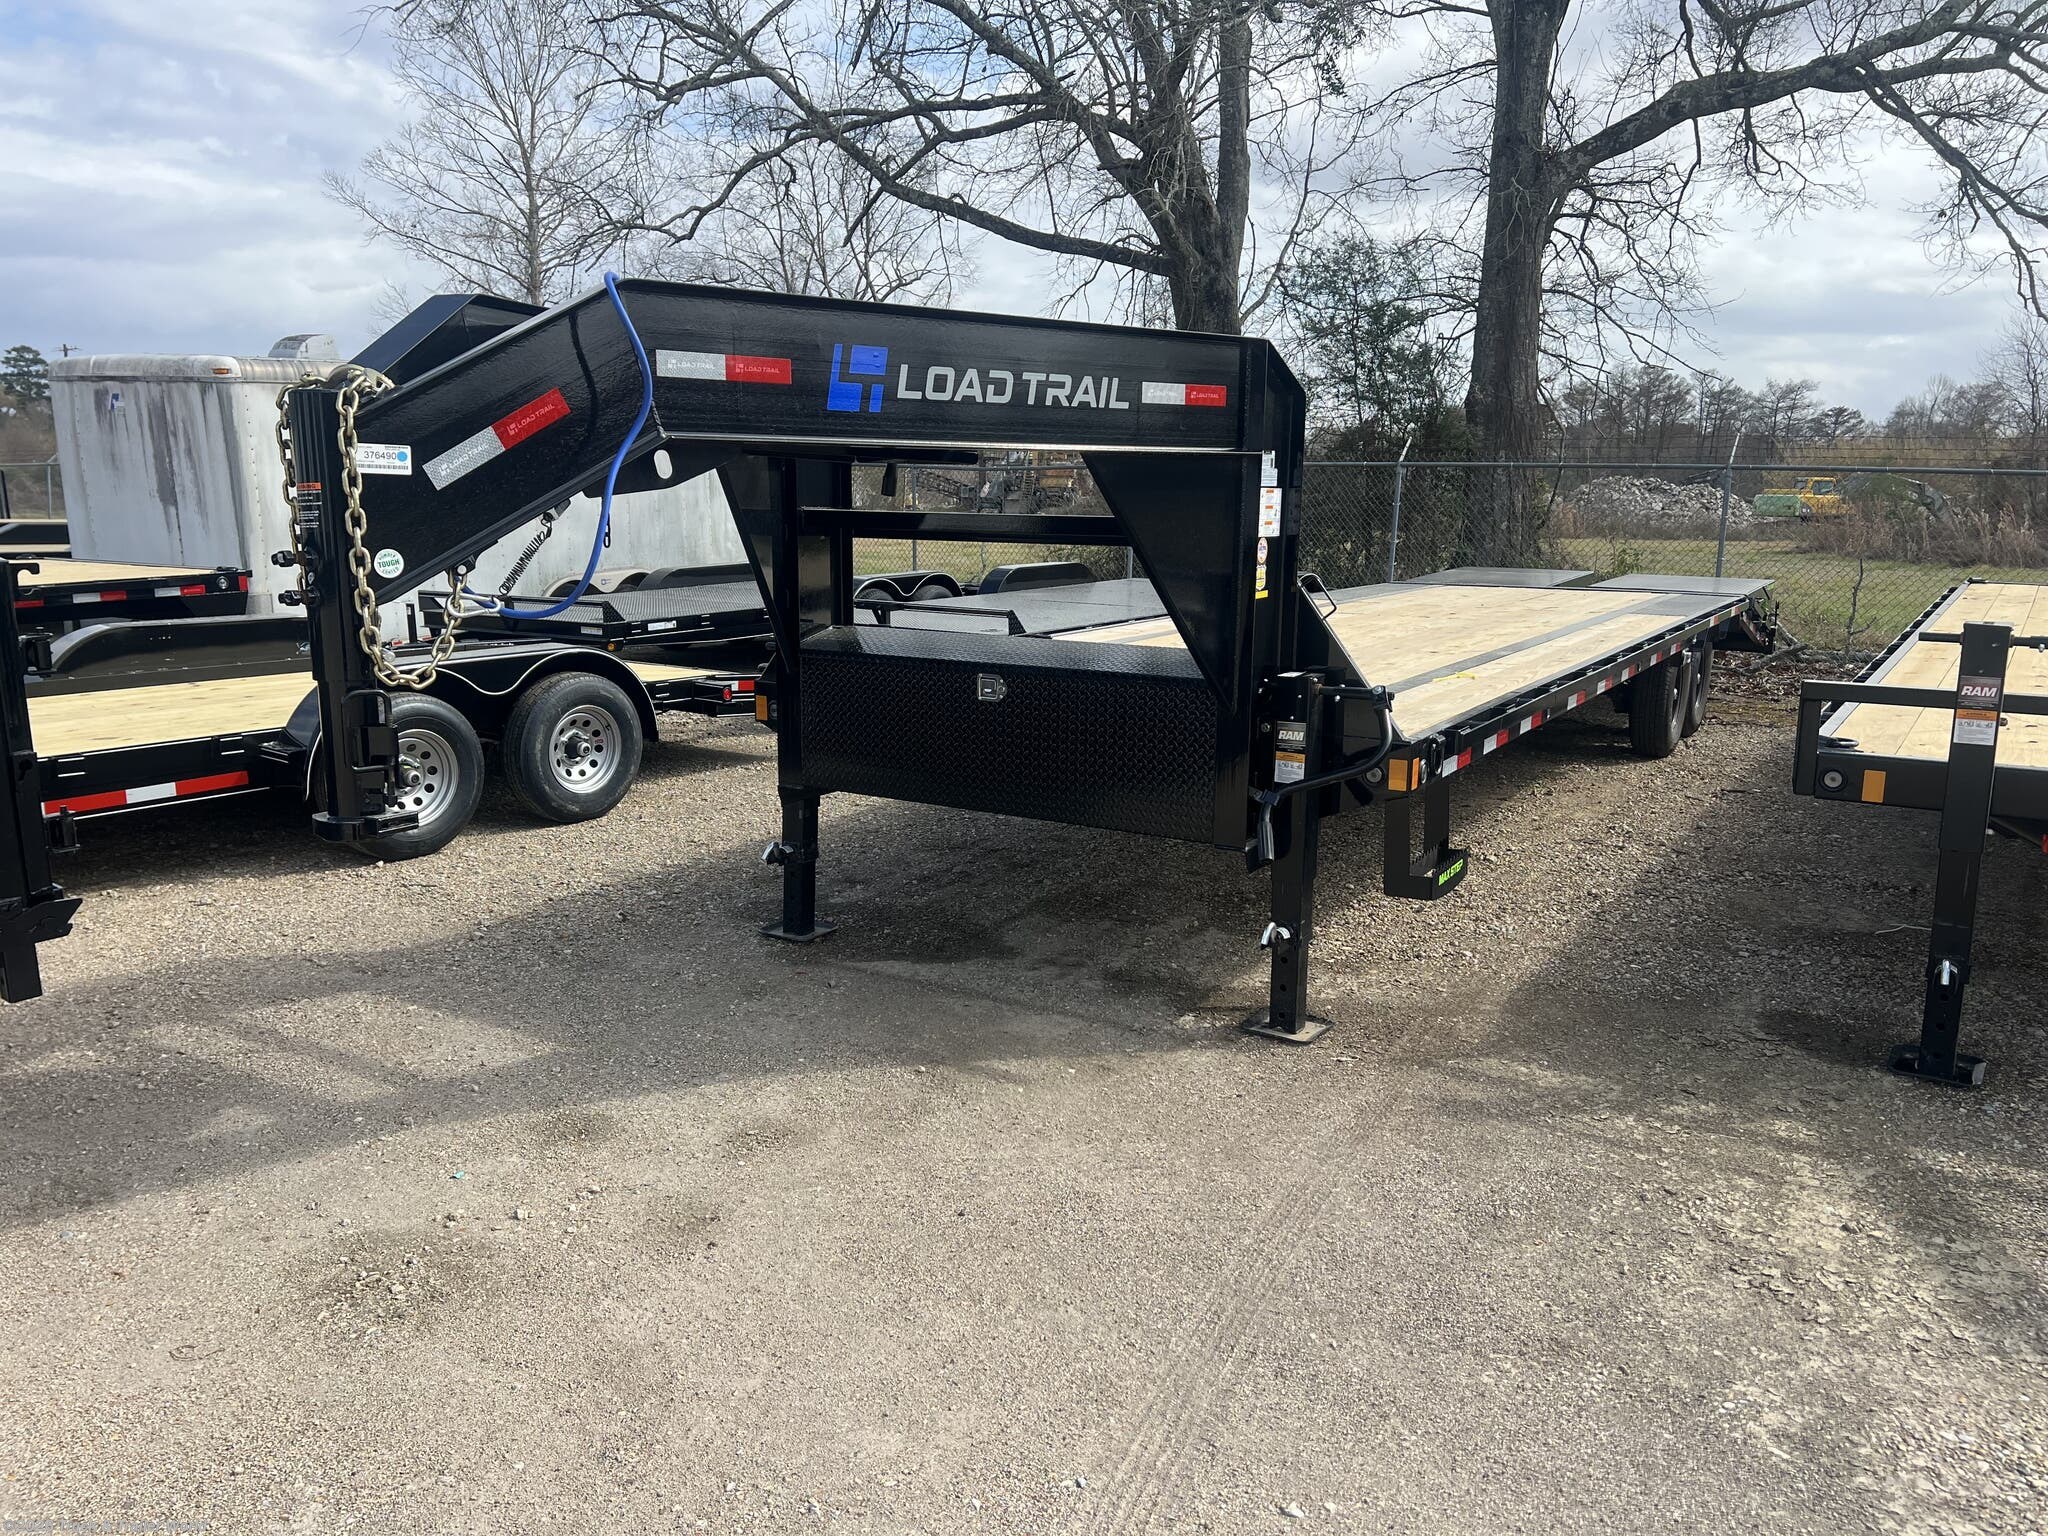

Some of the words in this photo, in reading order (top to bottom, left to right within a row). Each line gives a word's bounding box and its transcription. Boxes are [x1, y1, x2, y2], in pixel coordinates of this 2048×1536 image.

[897, 363, 1014, 403] LOAD
[1022, 371, 1130, 410] TRAIL
[517, 414, 536, 429] LOAD
[535, 403, 555, 418] TRAIL
[363, 450, 397, 460] 376490
[377, 558, 400, 569] TOUGH
[1961, 685, 1998, 698] RAM
[1278, 730, 1305, 741] RAM
[1450, 859, 1463, 876] STEP
